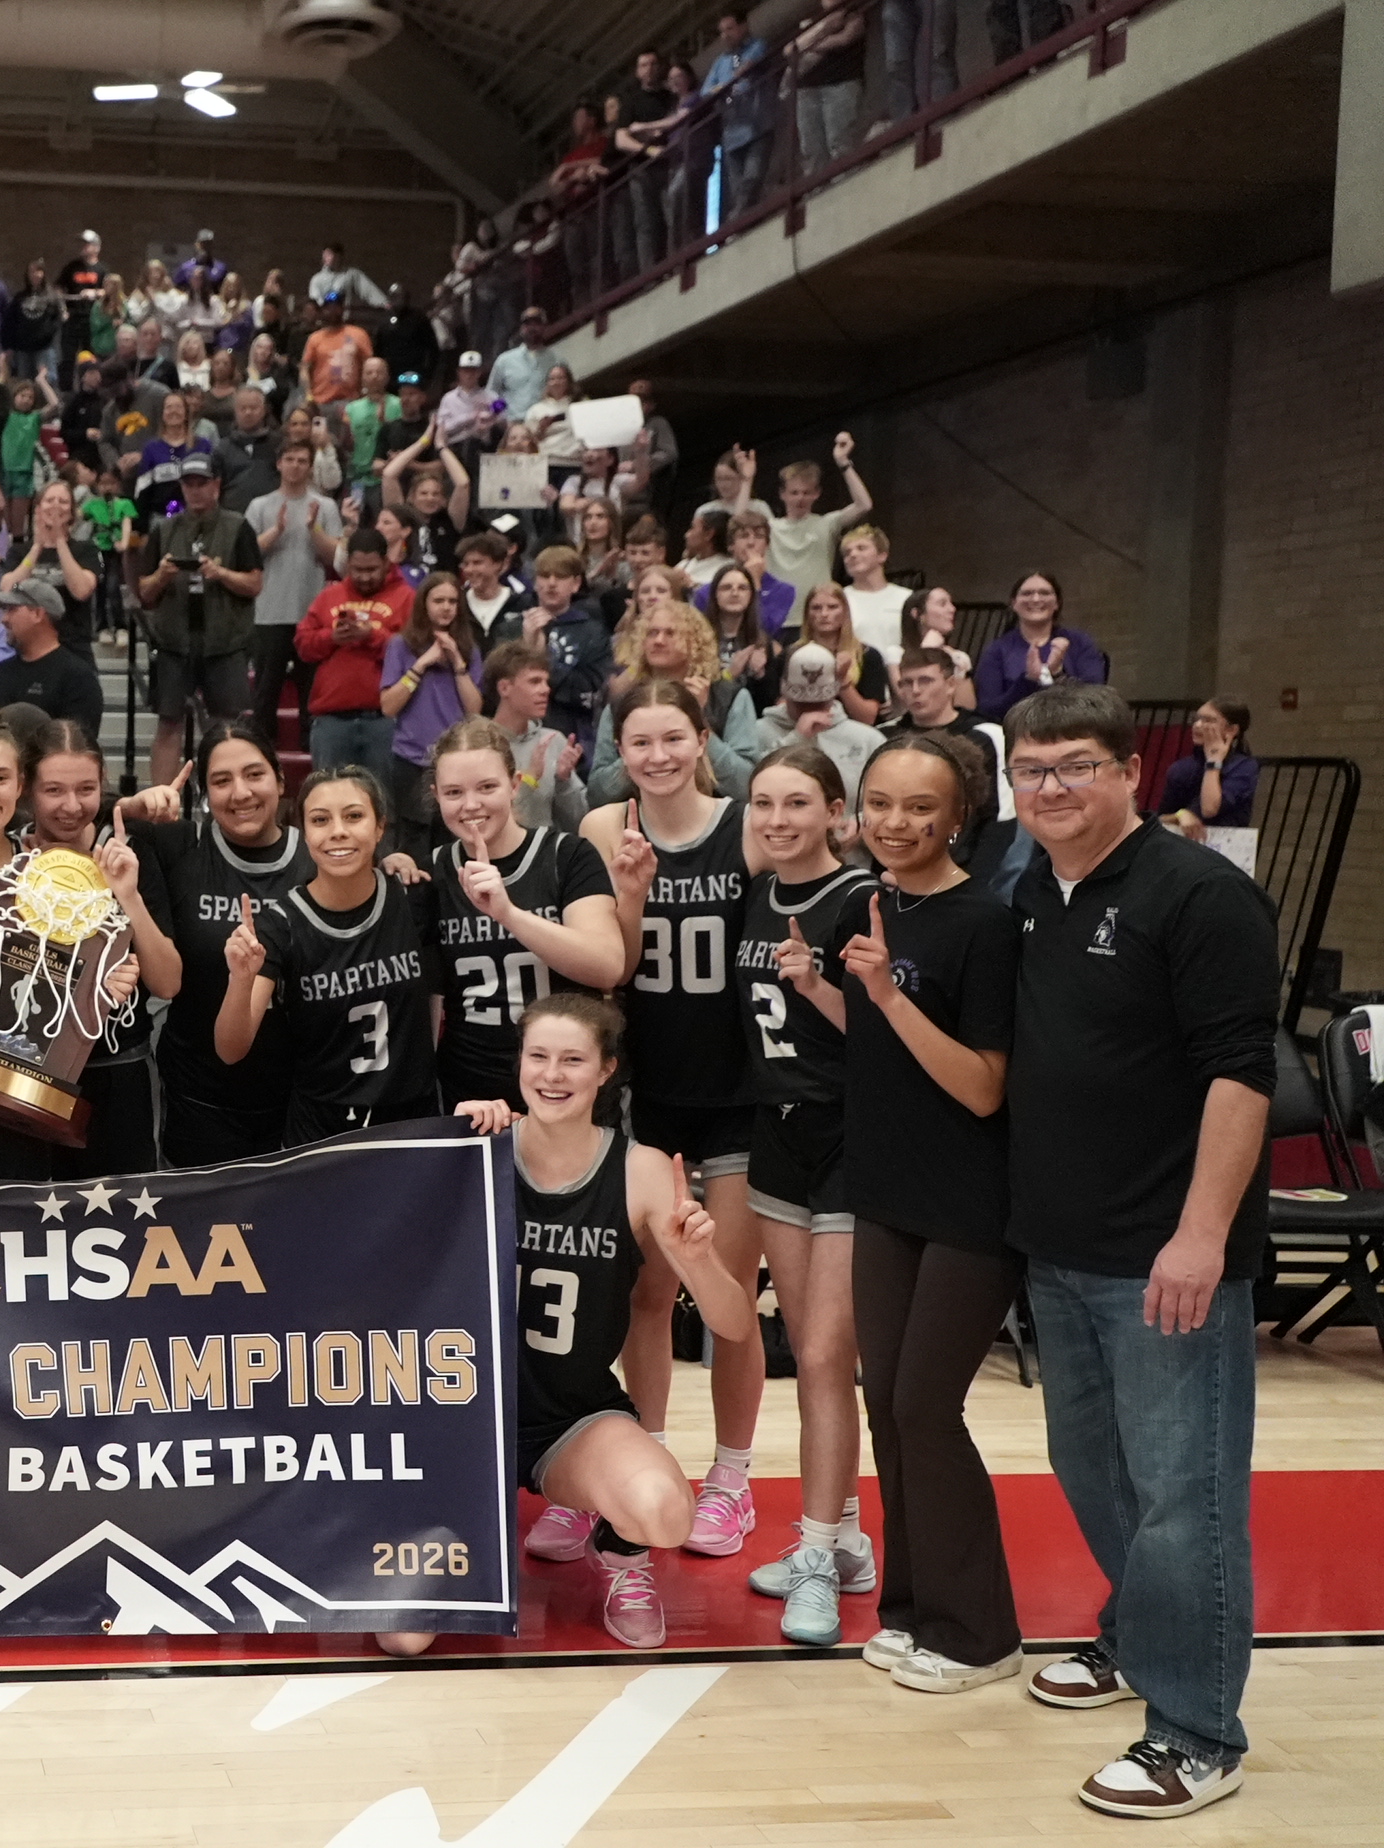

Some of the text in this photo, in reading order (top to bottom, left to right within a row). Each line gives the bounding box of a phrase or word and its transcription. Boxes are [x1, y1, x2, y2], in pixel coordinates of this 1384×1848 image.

[300, 950, 422, 1000] SPARTANS
[455, 952, 551, 1026] 20
[634, 915, 726, 994] 30
[347, 1000, 390, 1075] 3
[751, 982, 798, 1059] 2
[10, 1328, 478, 1420] CHAMPIONS
[7, 1432, 424, 1492] BASKETBALL
[371, 1541, 470, 1578] 2026
